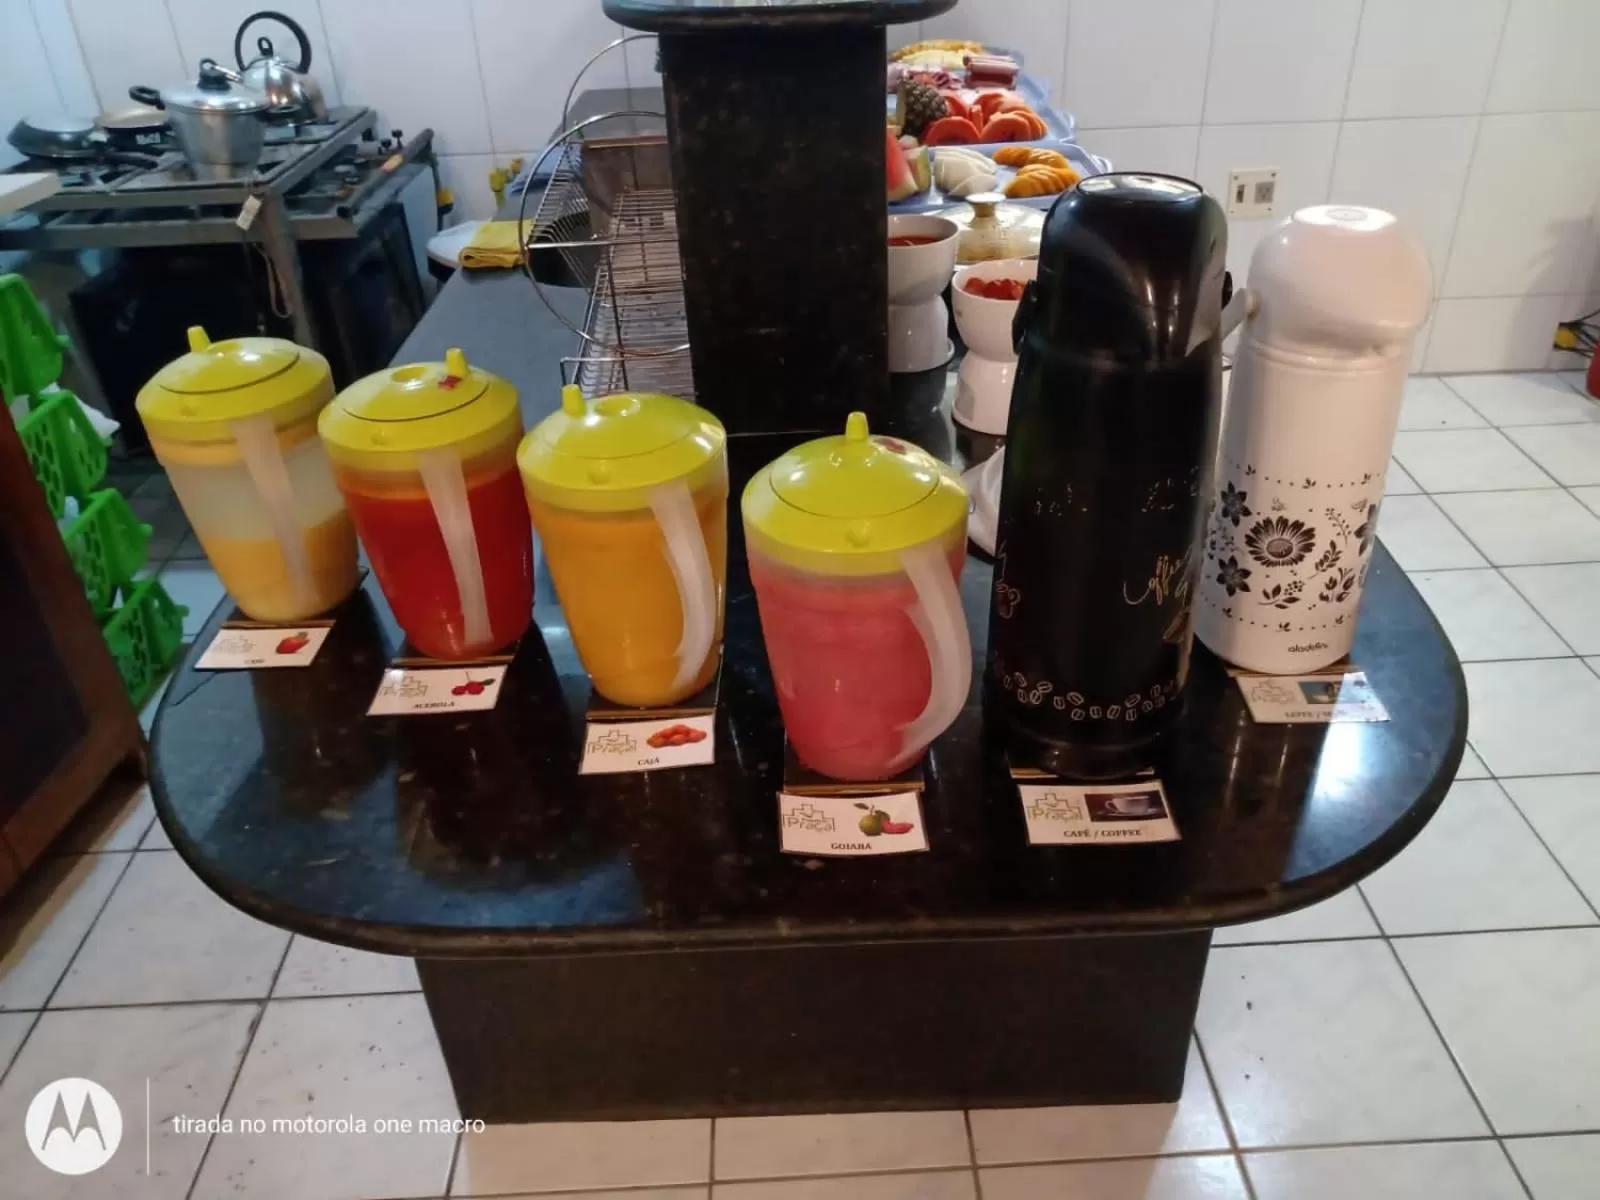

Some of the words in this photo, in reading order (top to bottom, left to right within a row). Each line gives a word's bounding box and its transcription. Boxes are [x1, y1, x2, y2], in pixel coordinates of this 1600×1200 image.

[1063, 828, 1091, 838] CAFÉ
[1101, 828, 1143, 838] COFFEE
[831, 842, 873, 851] GOIABA
